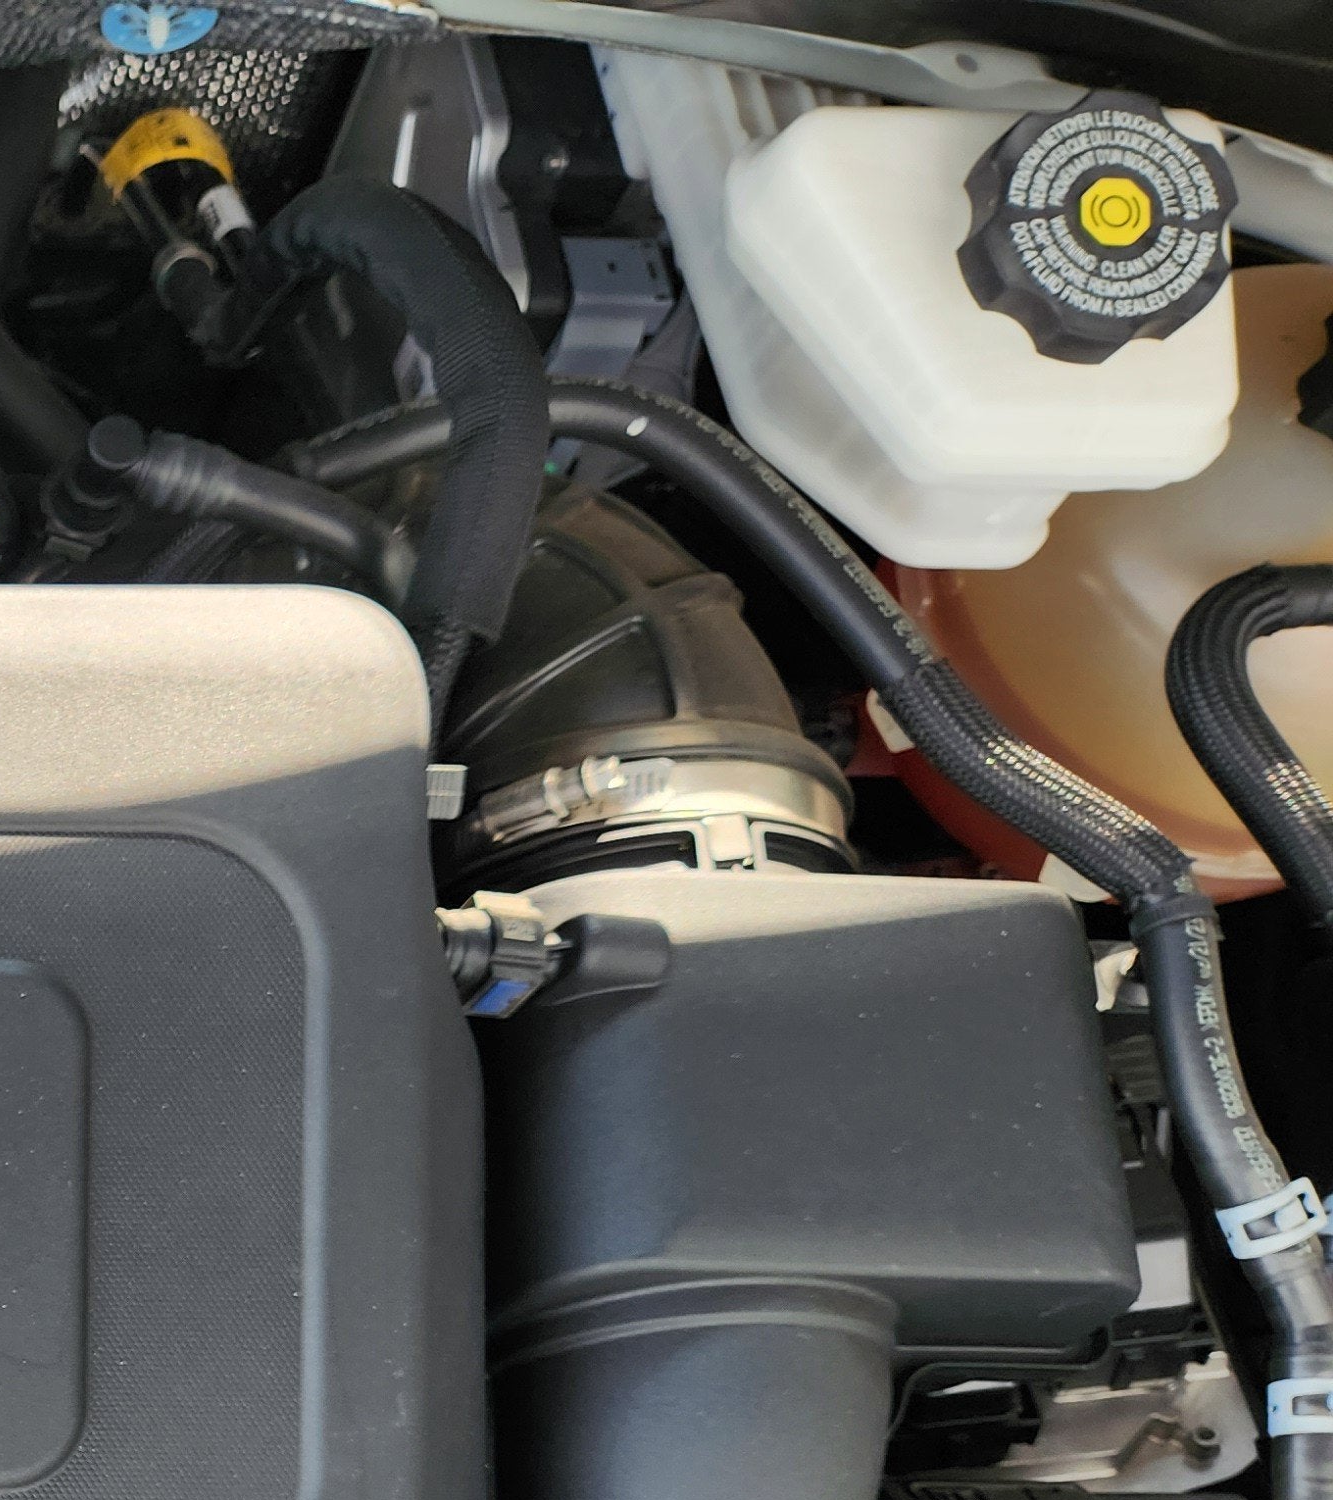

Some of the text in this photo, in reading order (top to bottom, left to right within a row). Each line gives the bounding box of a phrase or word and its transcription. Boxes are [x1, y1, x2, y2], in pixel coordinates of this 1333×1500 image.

[1092, 109, 1111, 128] LE
[1010, 221, 1034, 252] DOT
[1029, 218, 1053, 250] CAP
[1020, 246, 1039, 262] 4
[1162, 229, 1220, 302] CONTAINER
[1024, 255, 1065, 297] FLUID
[1101, 298, 1113, 315] A
[1114, 287, 1169, 318] SEALED
